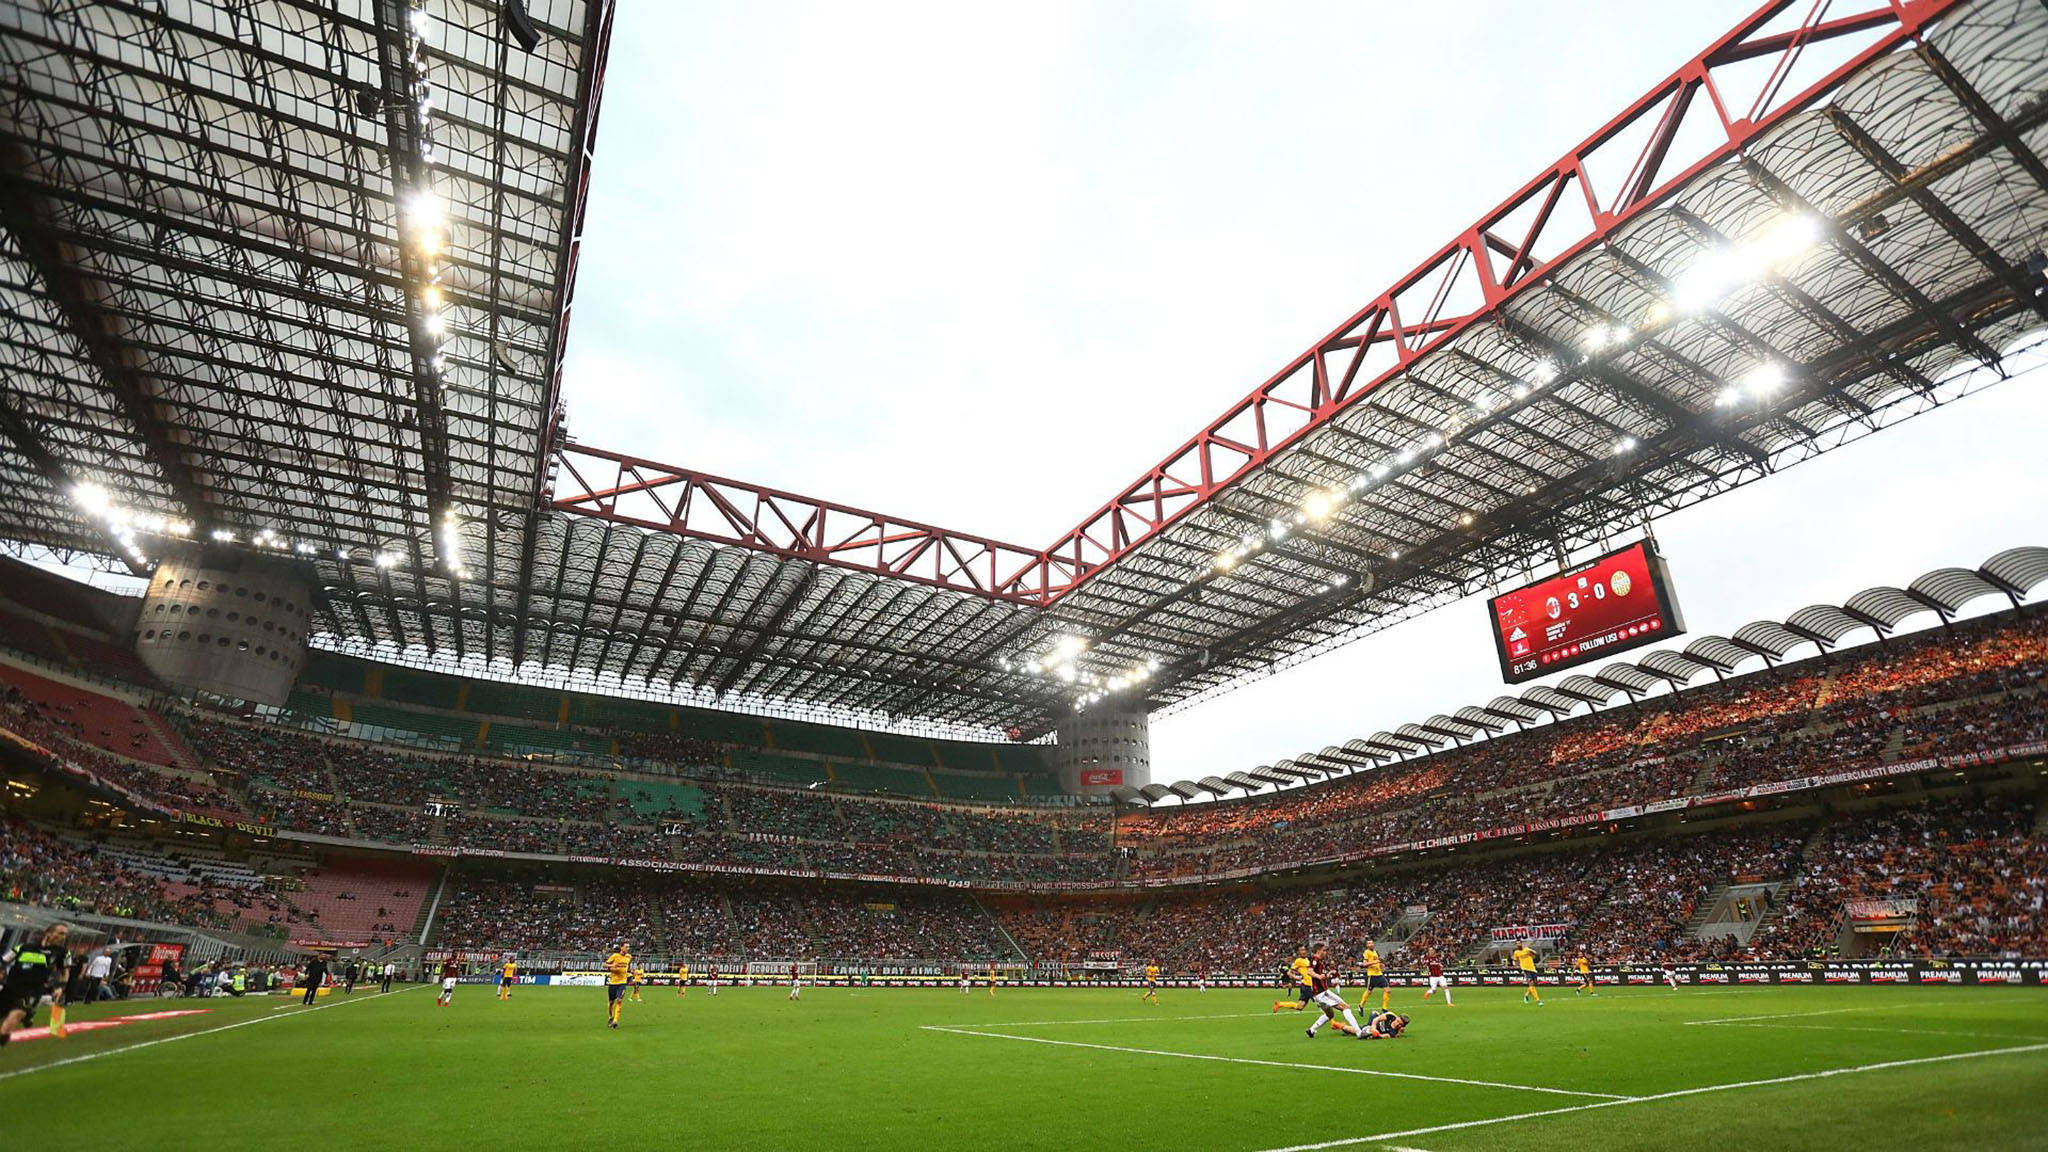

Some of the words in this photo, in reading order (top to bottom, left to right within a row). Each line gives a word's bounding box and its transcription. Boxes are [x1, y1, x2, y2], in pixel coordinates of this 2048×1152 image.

[1568, 592, 1579, 609] 3
[1594, 583, 1605, 599] 0
[1579, 636, 1605, 652] FOLLOW
[1513, 660, 1537, 675] 81:36
[1820, 767, 1887, 785] COMMERCIALISTI
[1888, 759, 1938, 774] ROSSONERI
[184, 812, 223, 828] BLACK
[236, 822, 276, 838] DEVIL
[620, 859, 703, 872] ASSOCIAZIONE
[705, 864, 753, 874] ITALIANA
[754, 867, 787, 877] MILAN
[789, 870, 817, 878] CLUB
[1492, 928, 1528, 941] MARCO
[520, 975, 536, 984] TIM
[1824, 971, 1860, 979] PREMIUM
[1870, 971, 1908, 979] PREMIUM
[1920, 970, 1961, 978] PREMIUM
[1977, 970, 2021, 979] PREMIUM
